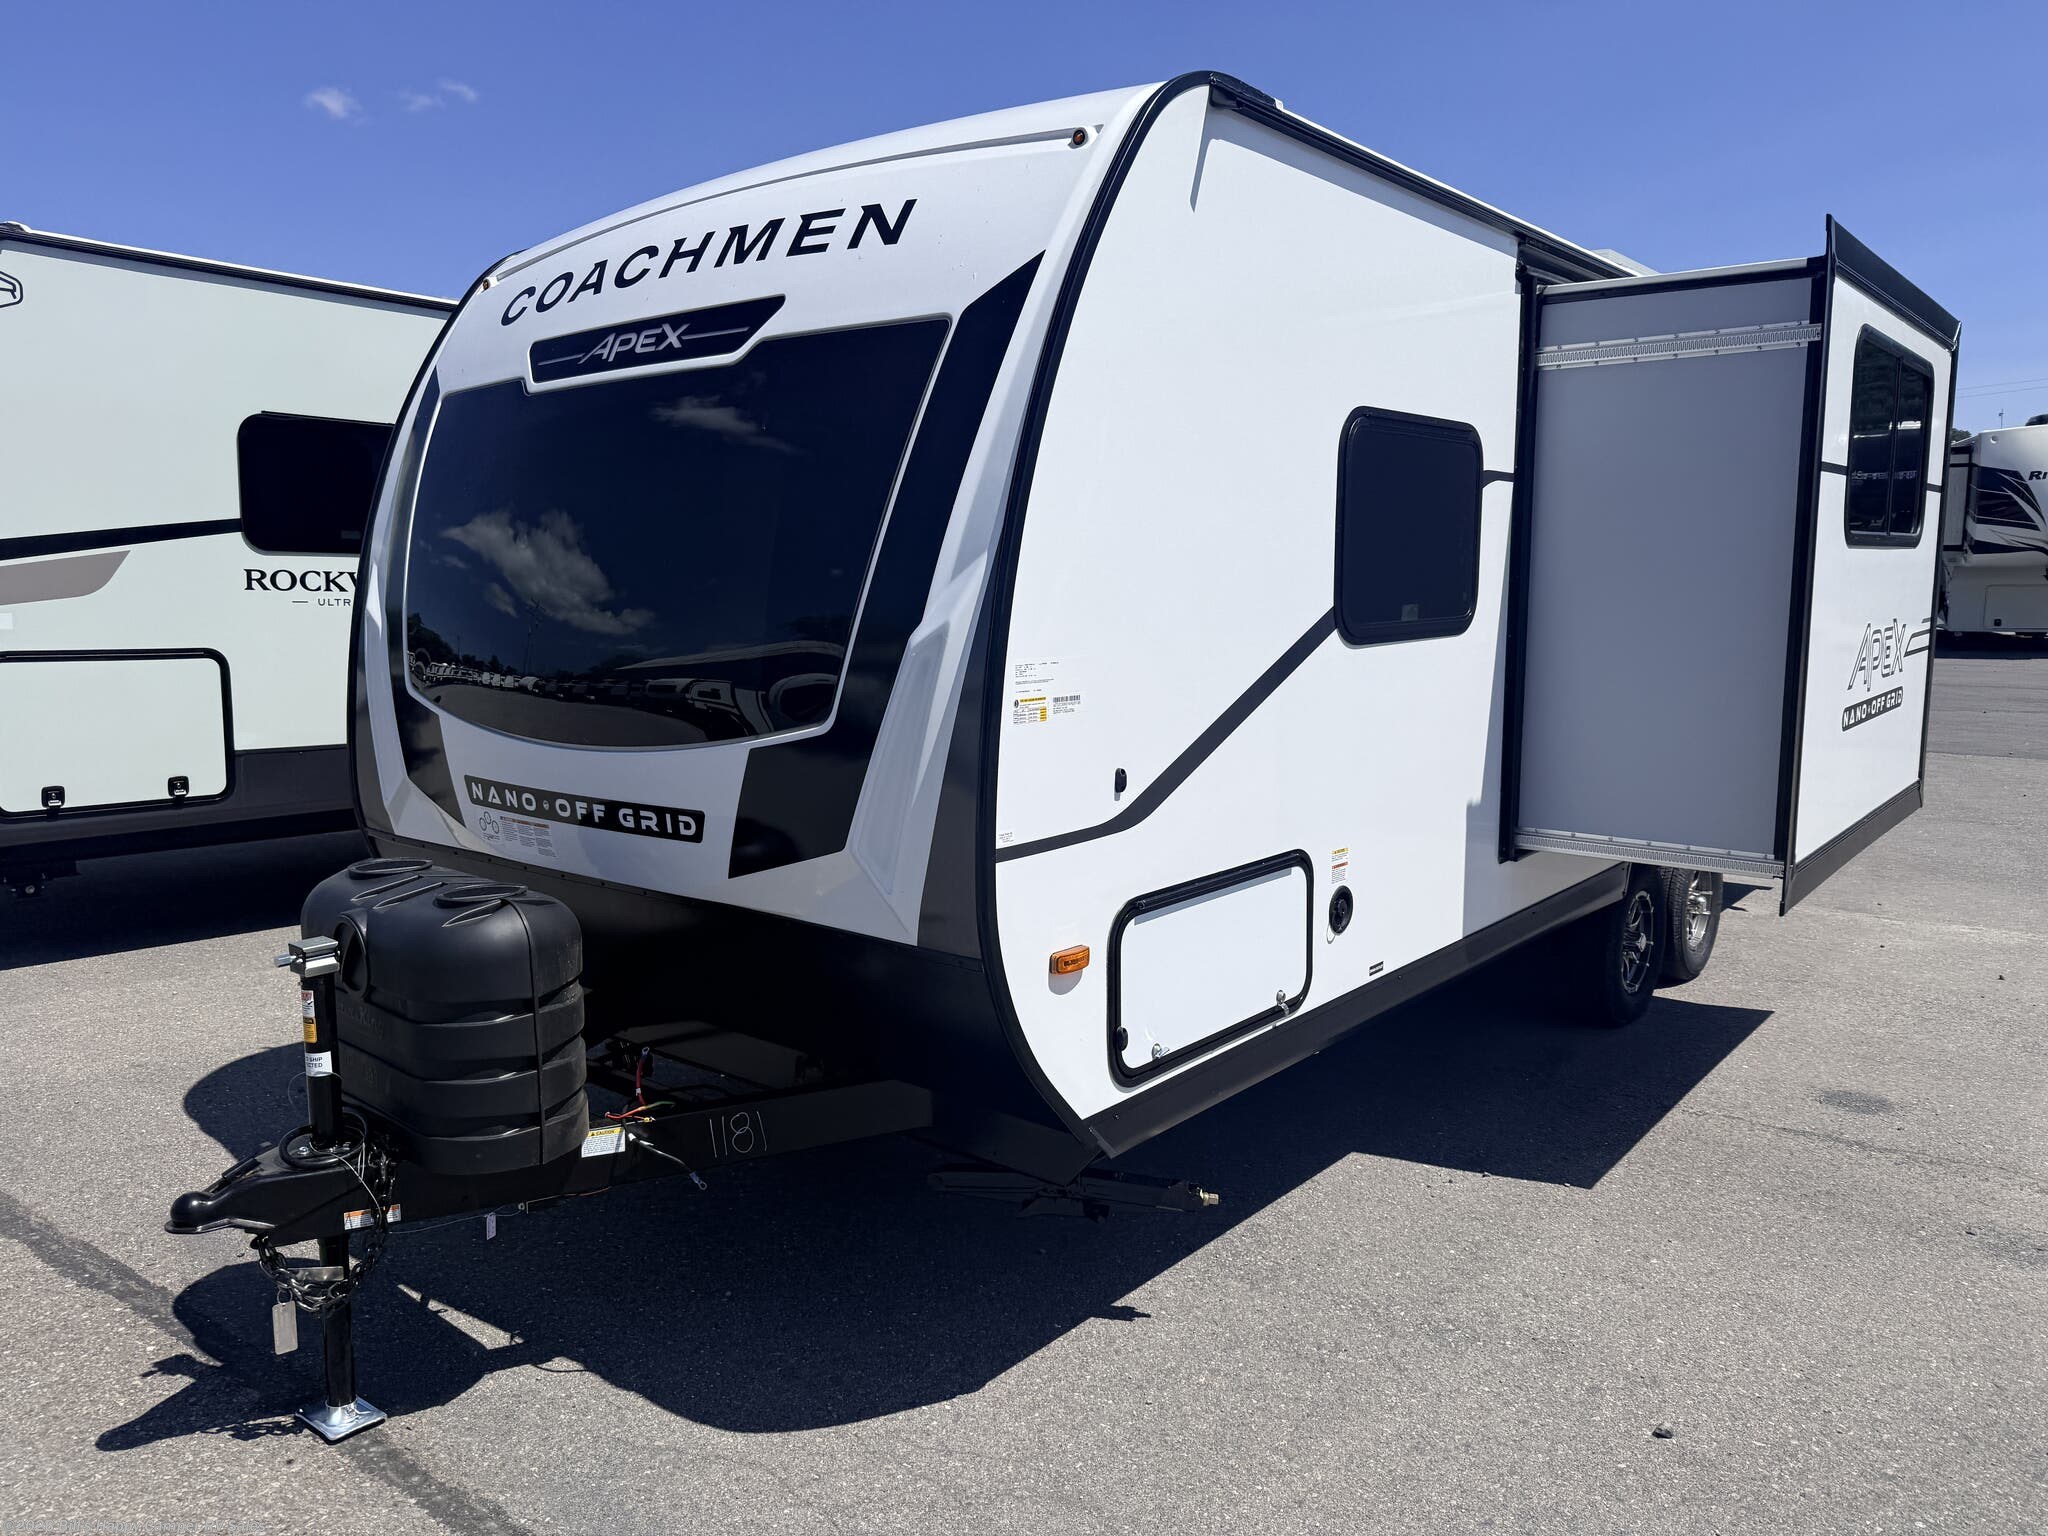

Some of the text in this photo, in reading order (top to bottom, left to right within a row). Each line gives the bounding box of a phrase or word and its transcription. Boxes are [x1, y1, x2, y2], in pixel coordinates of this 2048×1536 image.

[501, 198, 918, 327] COACHMEN
[577, 323, 690, 364] APEX
[1847, 618, 1907, 692] APEX
[1843, 690, 1903, 728] NANO OFF GRID
[471, 782, 537, 811] NANO
[555, 798, 606, 823] OFF
[618, 808, 696, 836] GRID
[709, 1111, 767, 1158] 1181
